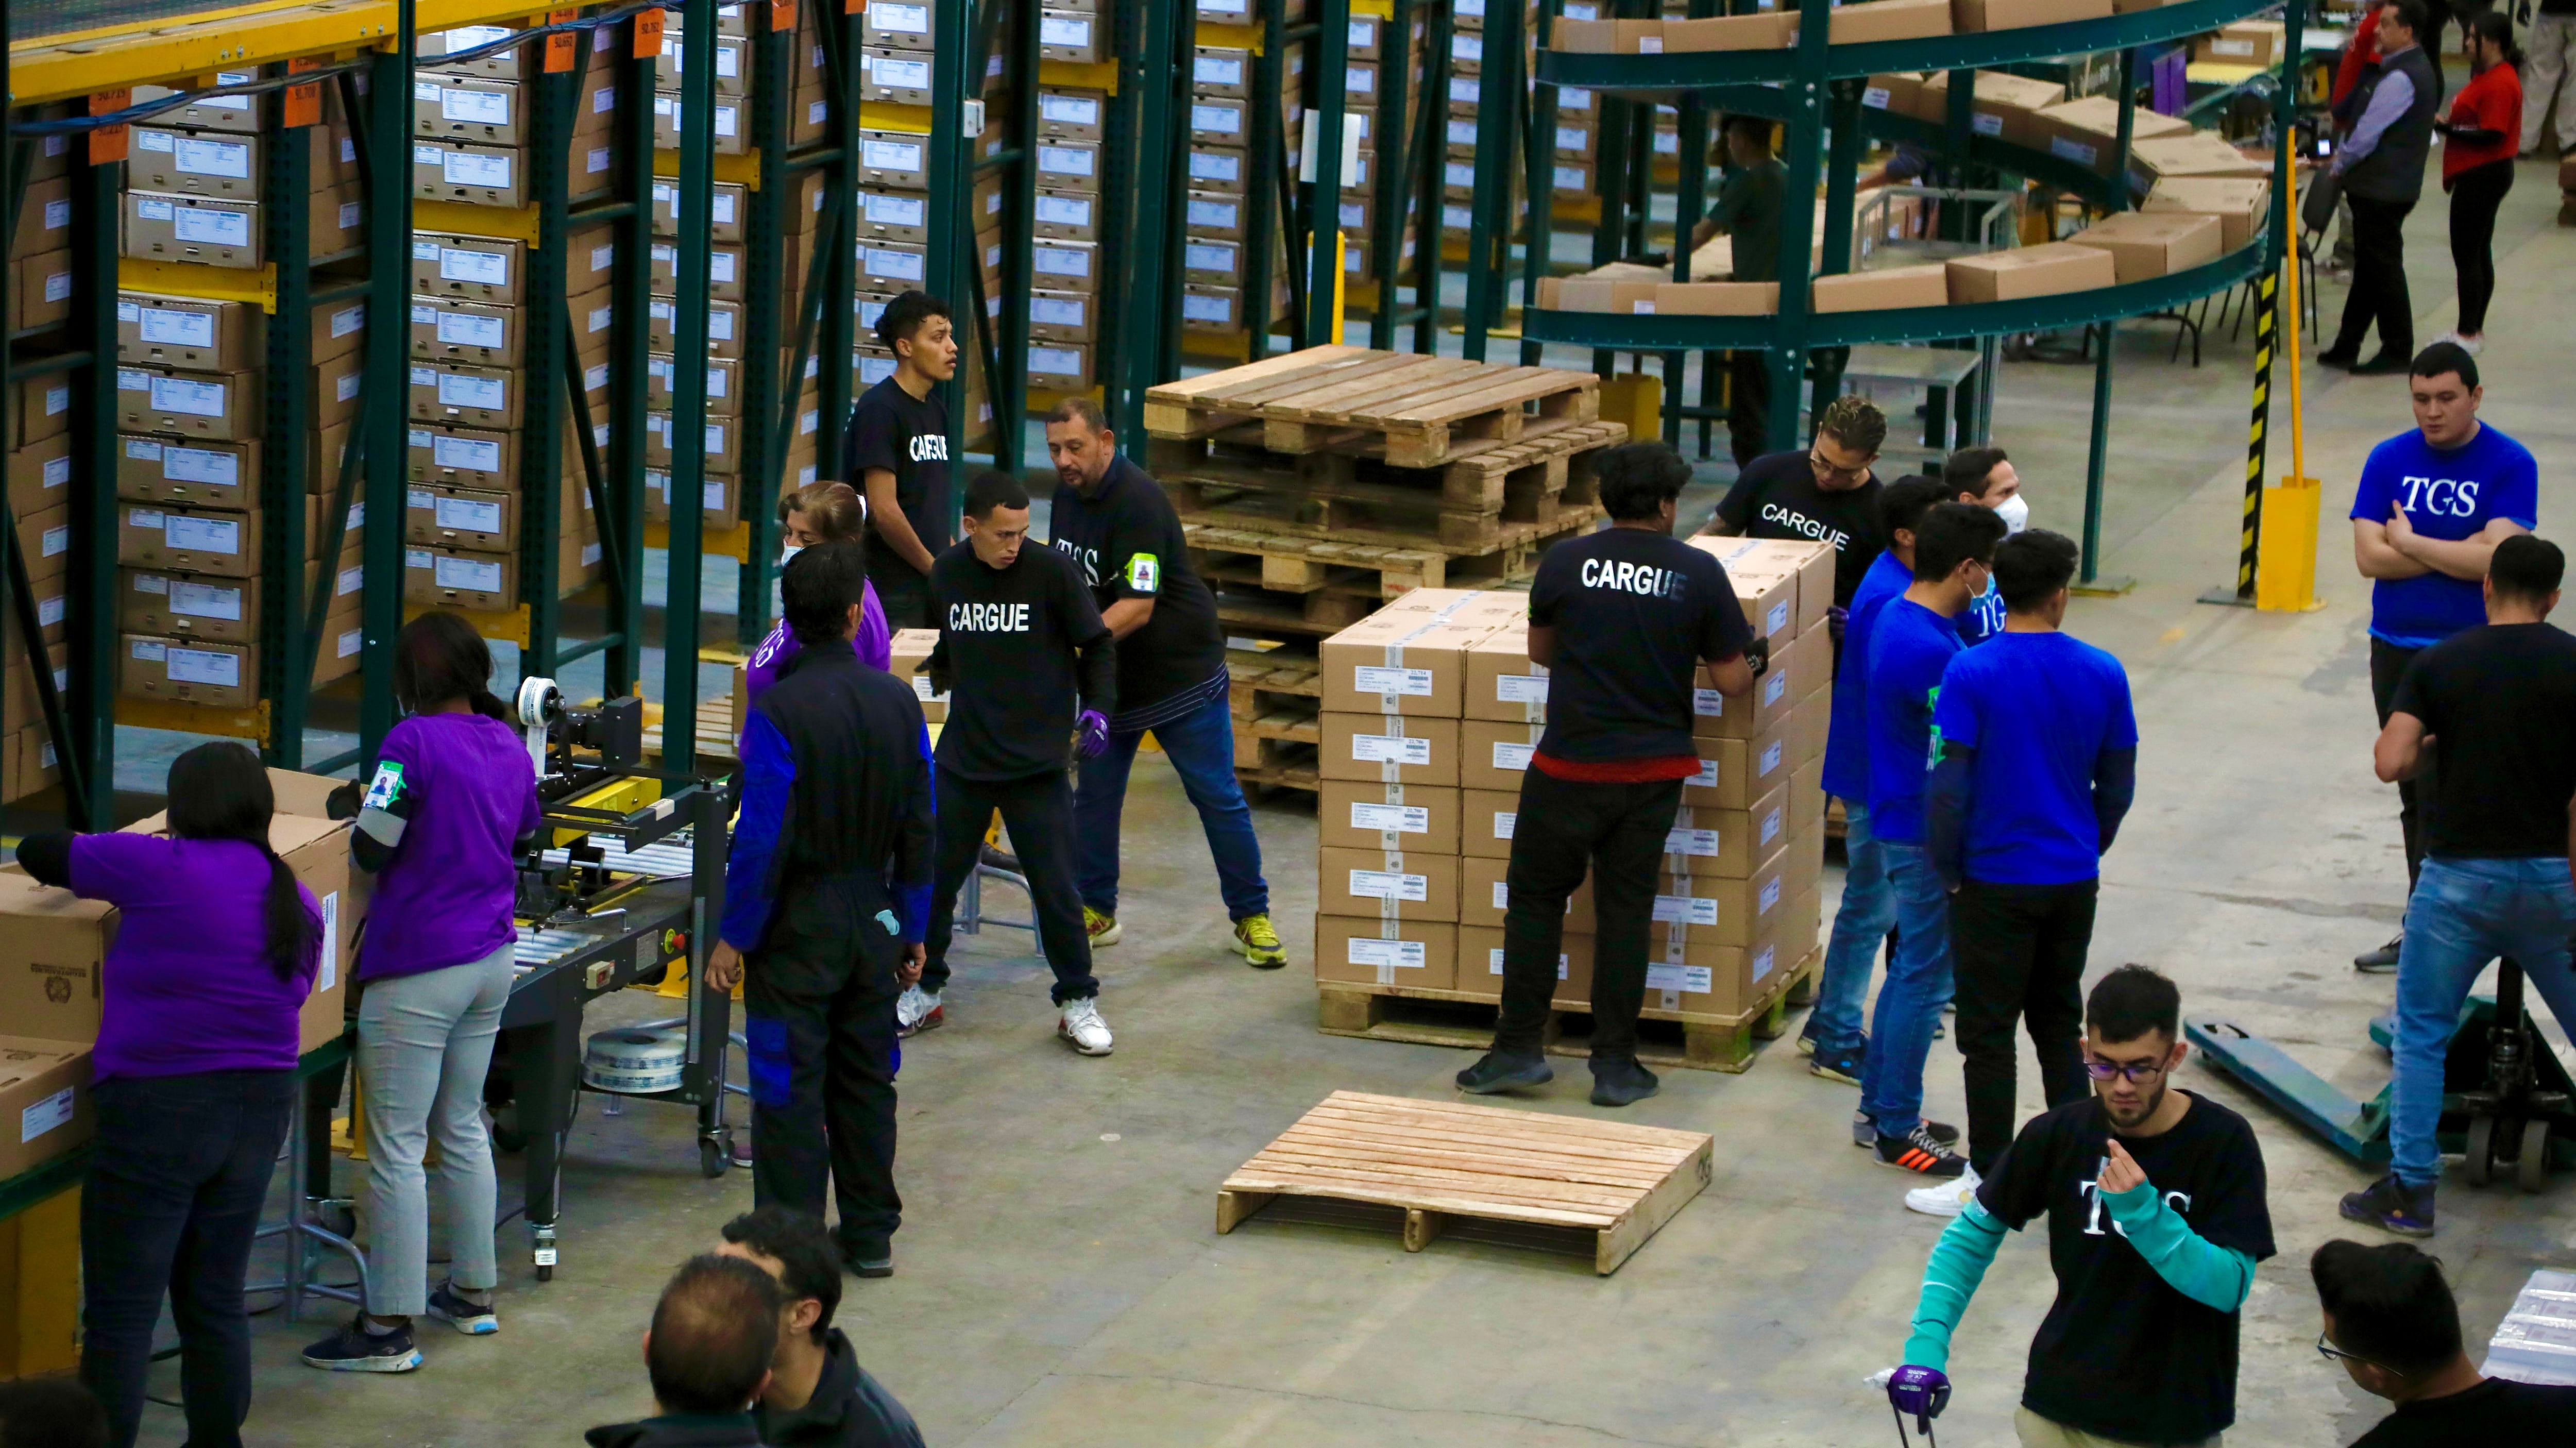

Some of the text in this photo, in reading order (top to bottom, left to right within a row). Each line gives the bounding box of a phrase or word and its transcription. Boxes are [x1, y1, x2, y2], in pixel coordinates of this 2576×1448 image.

[2402, 475, 2480, 518] TGS
[1762, 503, 1850, 551] CARGUE
[1582, 558, 1688, 602] CARGUE
[950, 603, 1029, 632] CARGUE
